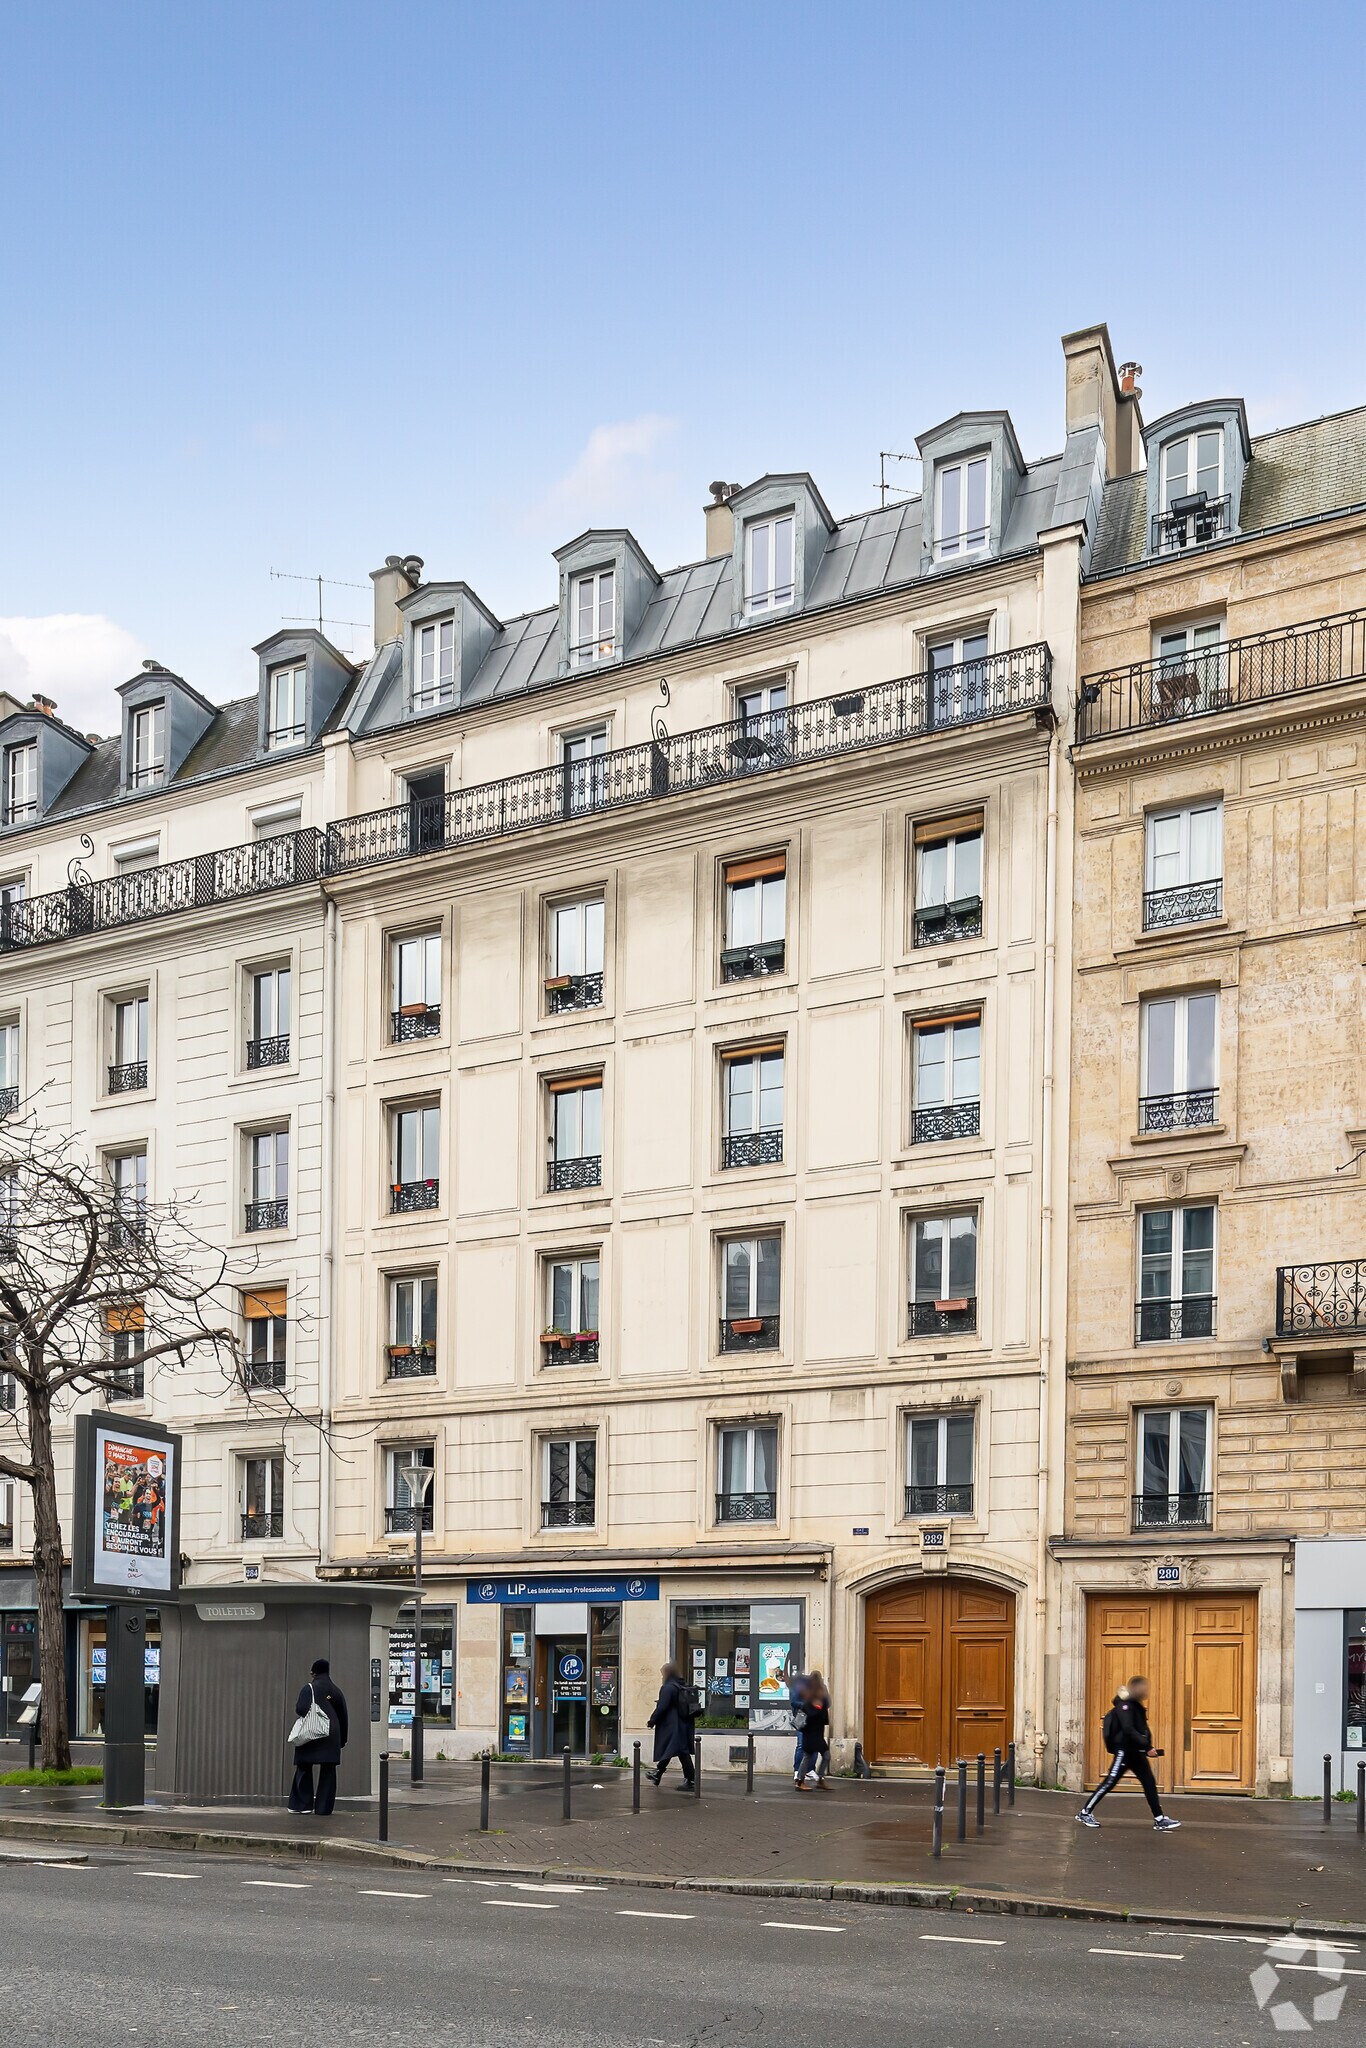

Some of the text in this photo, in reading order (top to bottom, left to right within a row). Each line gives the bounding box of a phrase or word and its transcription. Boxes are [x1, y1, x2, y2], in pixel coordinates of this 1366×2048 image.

[108, 1444, 133, 1454] DIMANCHE
[112, 1452, 126, 1460] MARS
[126, 1455, 138, 1463] 2024
[106, 1521, 127, 1531] VENEZ
[106, 1528, 151, 1541] ENCOURAGER,
[924, 1534, 943, 1544] 282
[106, 1535, 143, 1546] ILS AURONT
[106, 1542, 157, 1555] BESOIN DE VOUS
[245, 1569, 258, 1577] 284
[1158, 1568, 1178, 1579] 280
[507, 1583, 526, 1595] LIP
[538, 1586, 572, 1594] Intérimaires
[205, 1607, 256, 1616] TOILETTES
